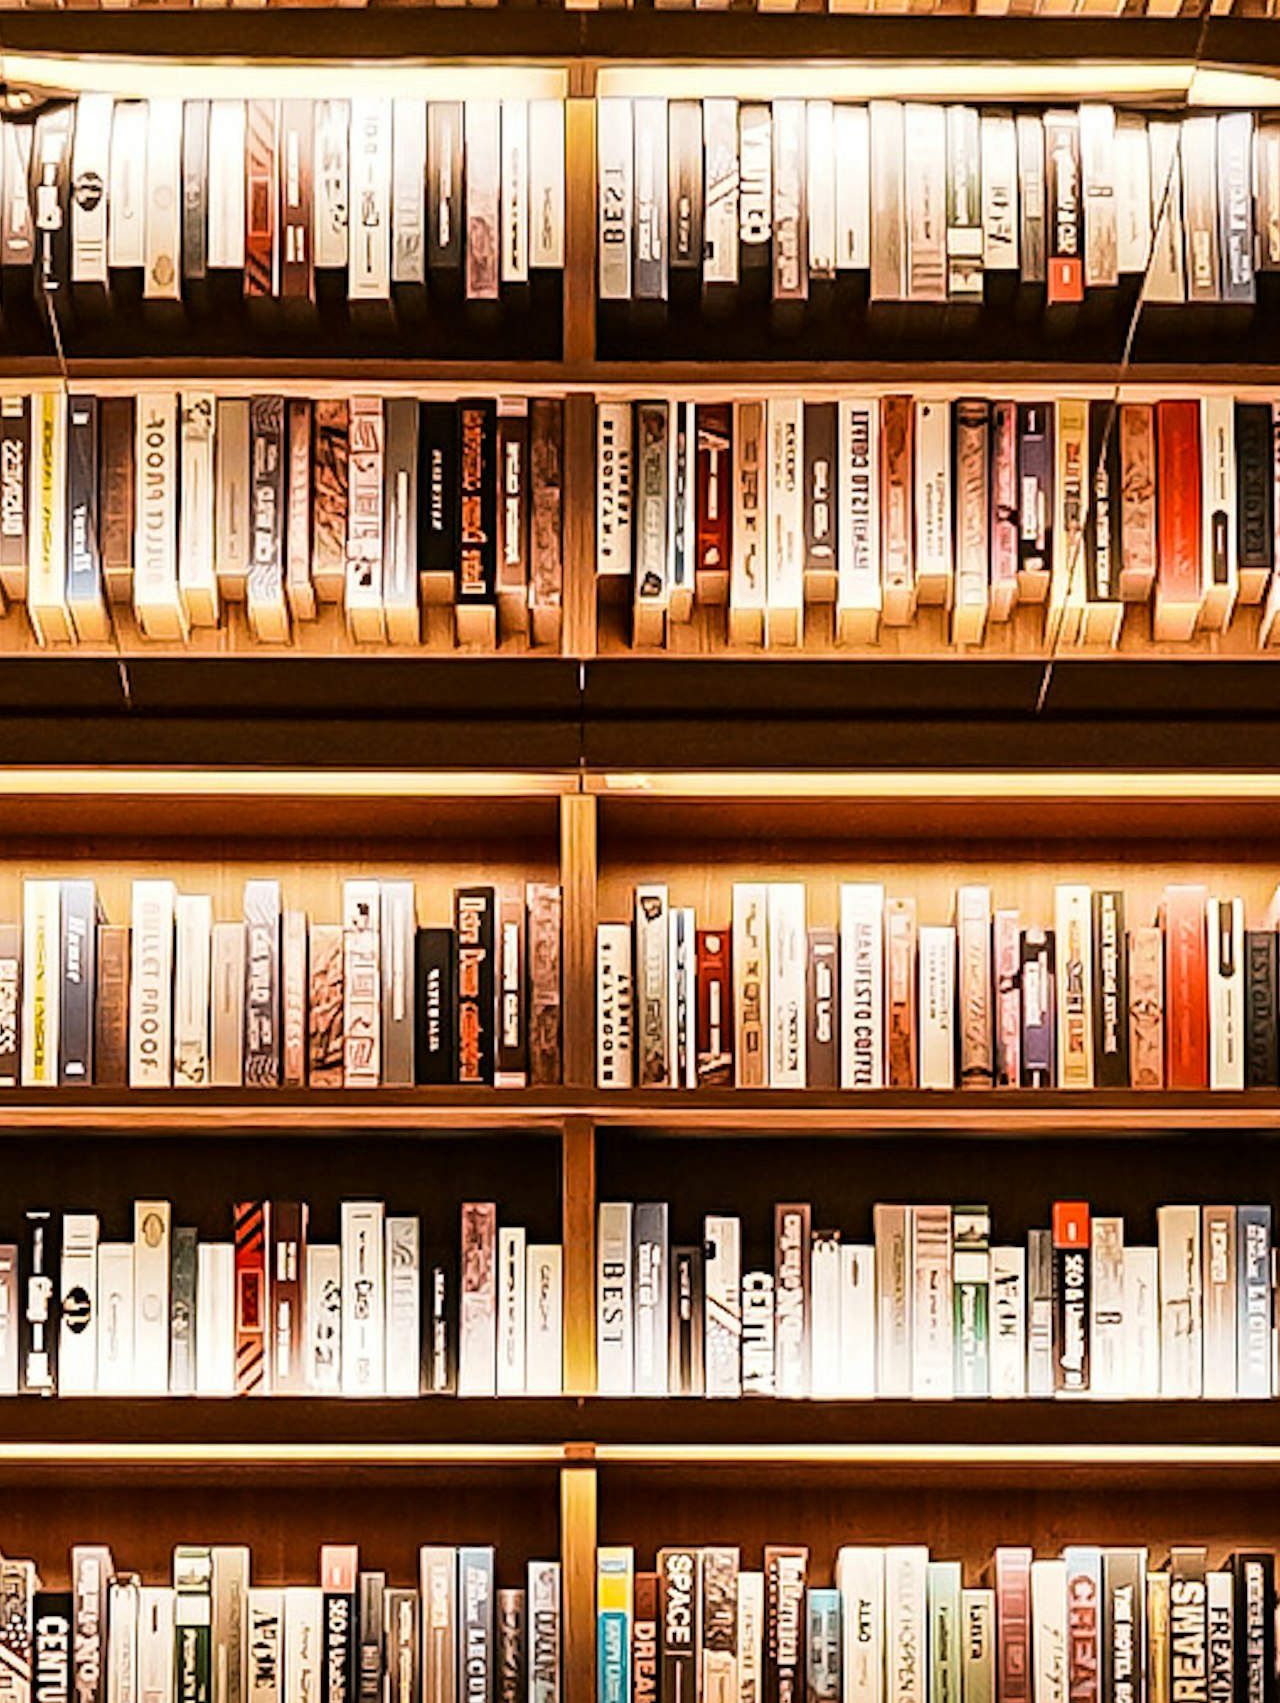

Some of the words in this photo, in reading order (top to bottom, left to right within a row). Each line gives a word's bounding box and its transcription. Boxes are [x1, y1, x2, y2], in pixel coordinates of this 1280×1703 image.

[602, 1262, 626, 1348] BEST
[328, 1598, 347, 1628] SEO
[666, 1554, 692, 1643] SPACE
